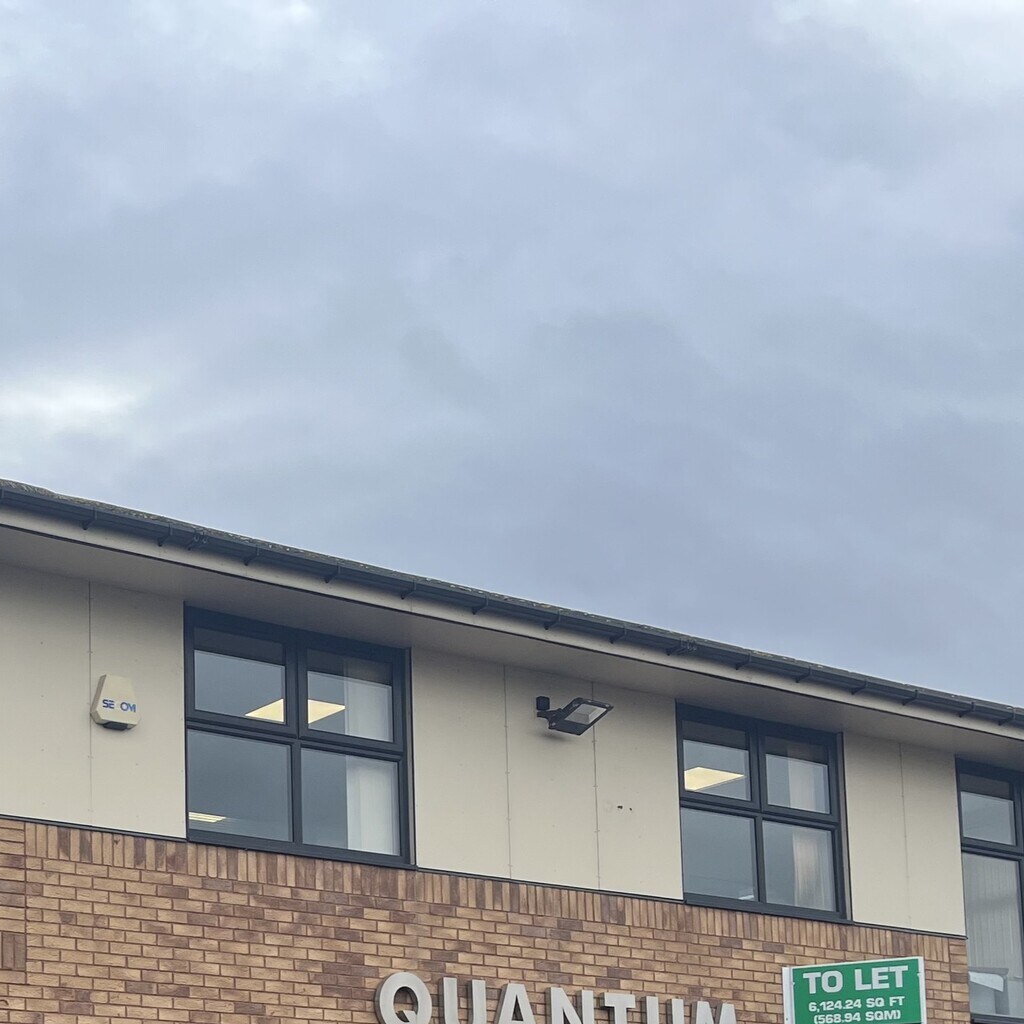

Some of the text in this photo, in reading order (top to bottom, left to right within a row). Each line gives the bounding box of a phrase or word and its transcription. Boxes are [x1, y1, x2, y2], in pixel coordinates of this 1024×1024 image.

[102, 699, 136, 713] SEOM
[802, 965, 908, 994] TO LET
[808, 996, 905, 1012] 6,124.24 SQ FT
[813, 1010, 901, 1024] (568.94 SQM)
